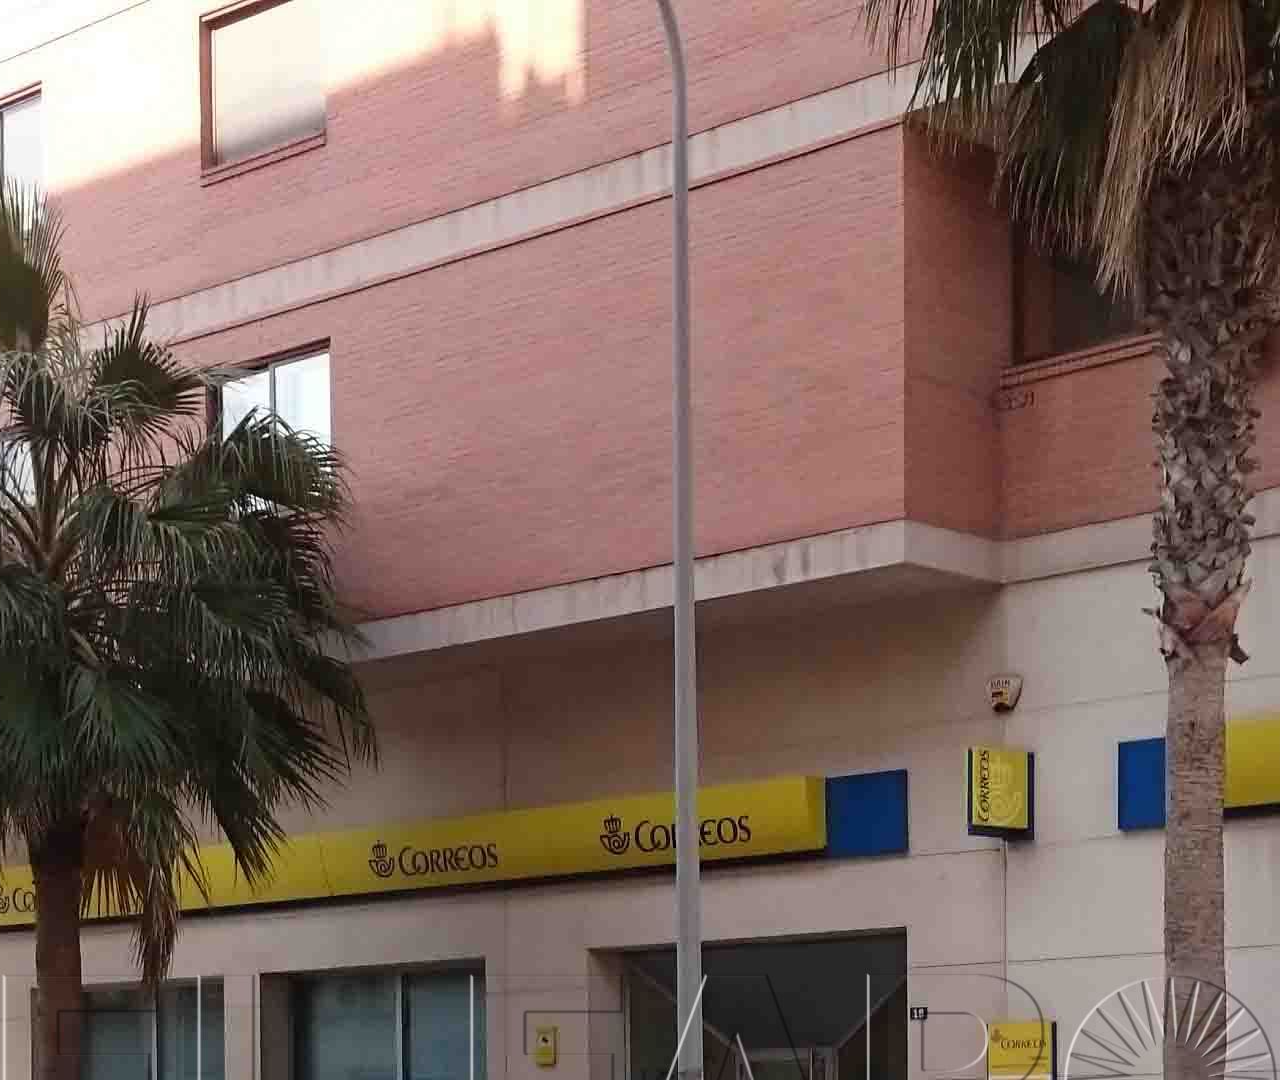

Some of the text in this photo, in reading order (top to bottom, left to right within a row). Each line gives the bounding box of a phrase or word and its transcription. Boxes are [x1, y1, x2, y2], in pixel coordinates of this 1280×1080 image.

[977, 749, 991, 823] CORREOS
[634, 814, 752, 853] COEOS
[397, 843, 499, 876] CORREOS
